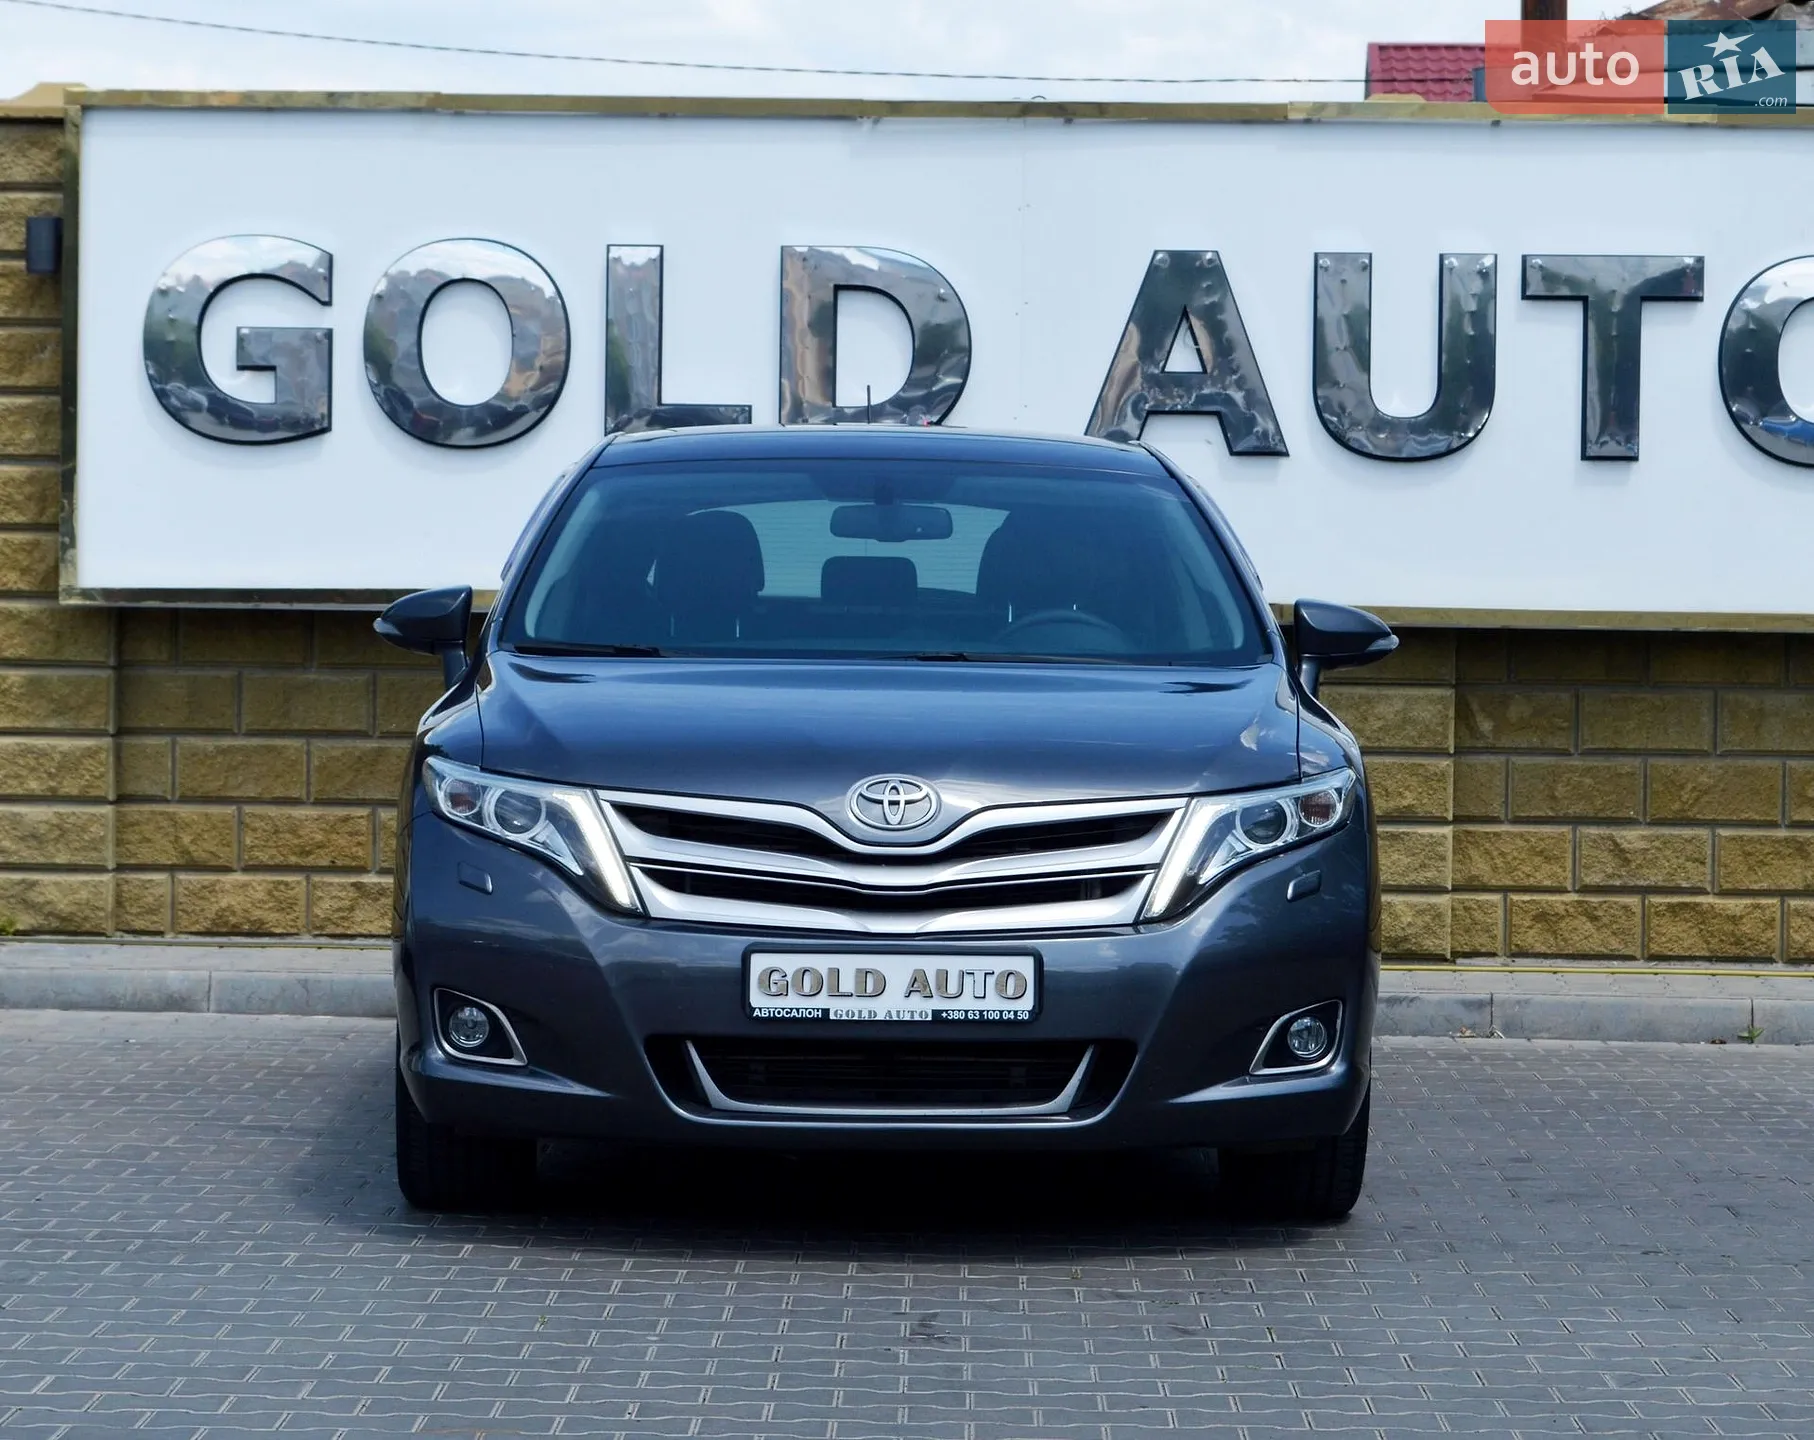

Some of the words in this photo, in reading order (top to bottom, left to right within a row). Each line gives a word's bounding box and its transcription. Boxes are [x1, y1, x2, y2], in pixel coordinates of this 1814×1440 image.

[143, 233, 973, 449] GOLD
[757, 966, 887, 998] GOLD
[904, 967, 1028, 1000] AUTO
[753, 1008, 822, 1018] АВТОСАЛОН
[833, 1009, 878, 1020] GOLD
[884, 1009, 929, 1020] AUTO
[941, 1010, 966, 1020] +380
[967, 1010, 980, 1020] 63
[982, 1010, 1000, 1020] 100
[1002, 1010, 1015, 1020] 04
[1017, 1010, 1029, 1020] 50
